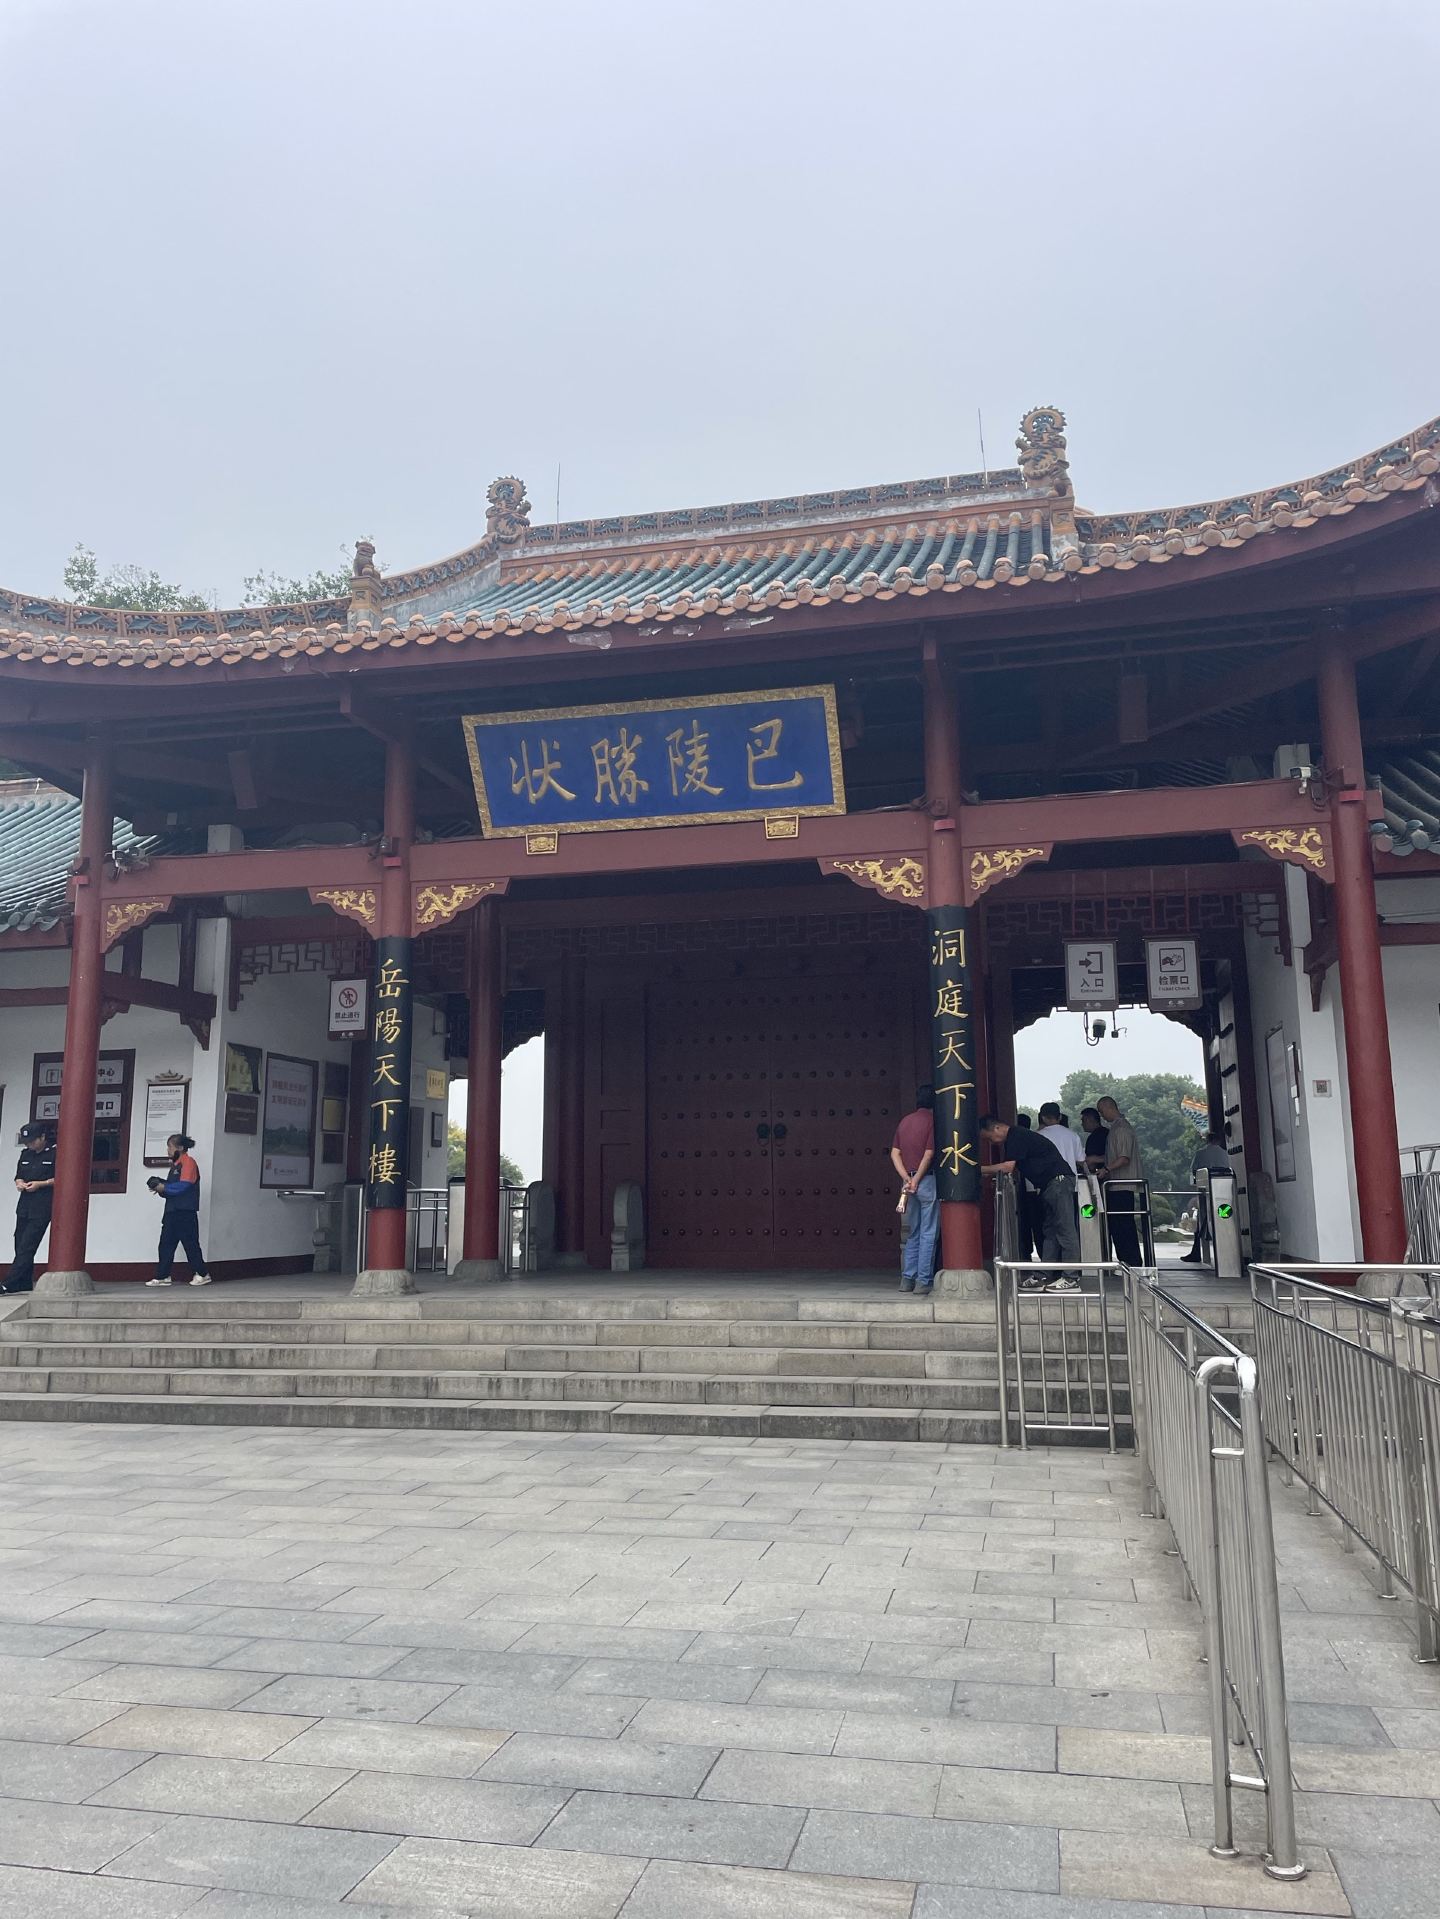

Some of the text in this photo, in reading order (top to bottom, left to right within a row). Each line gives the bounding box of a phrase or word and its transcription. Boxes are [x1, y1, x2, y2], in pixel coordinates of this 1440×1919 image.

[1080, 977, 1104, 987] 入口
[1159, 975, 1189, 985] 检票口
[369, 958, 409, 1185] 岳陽天下樓
[931, 928, 978, 1176] 洞庭天下水
